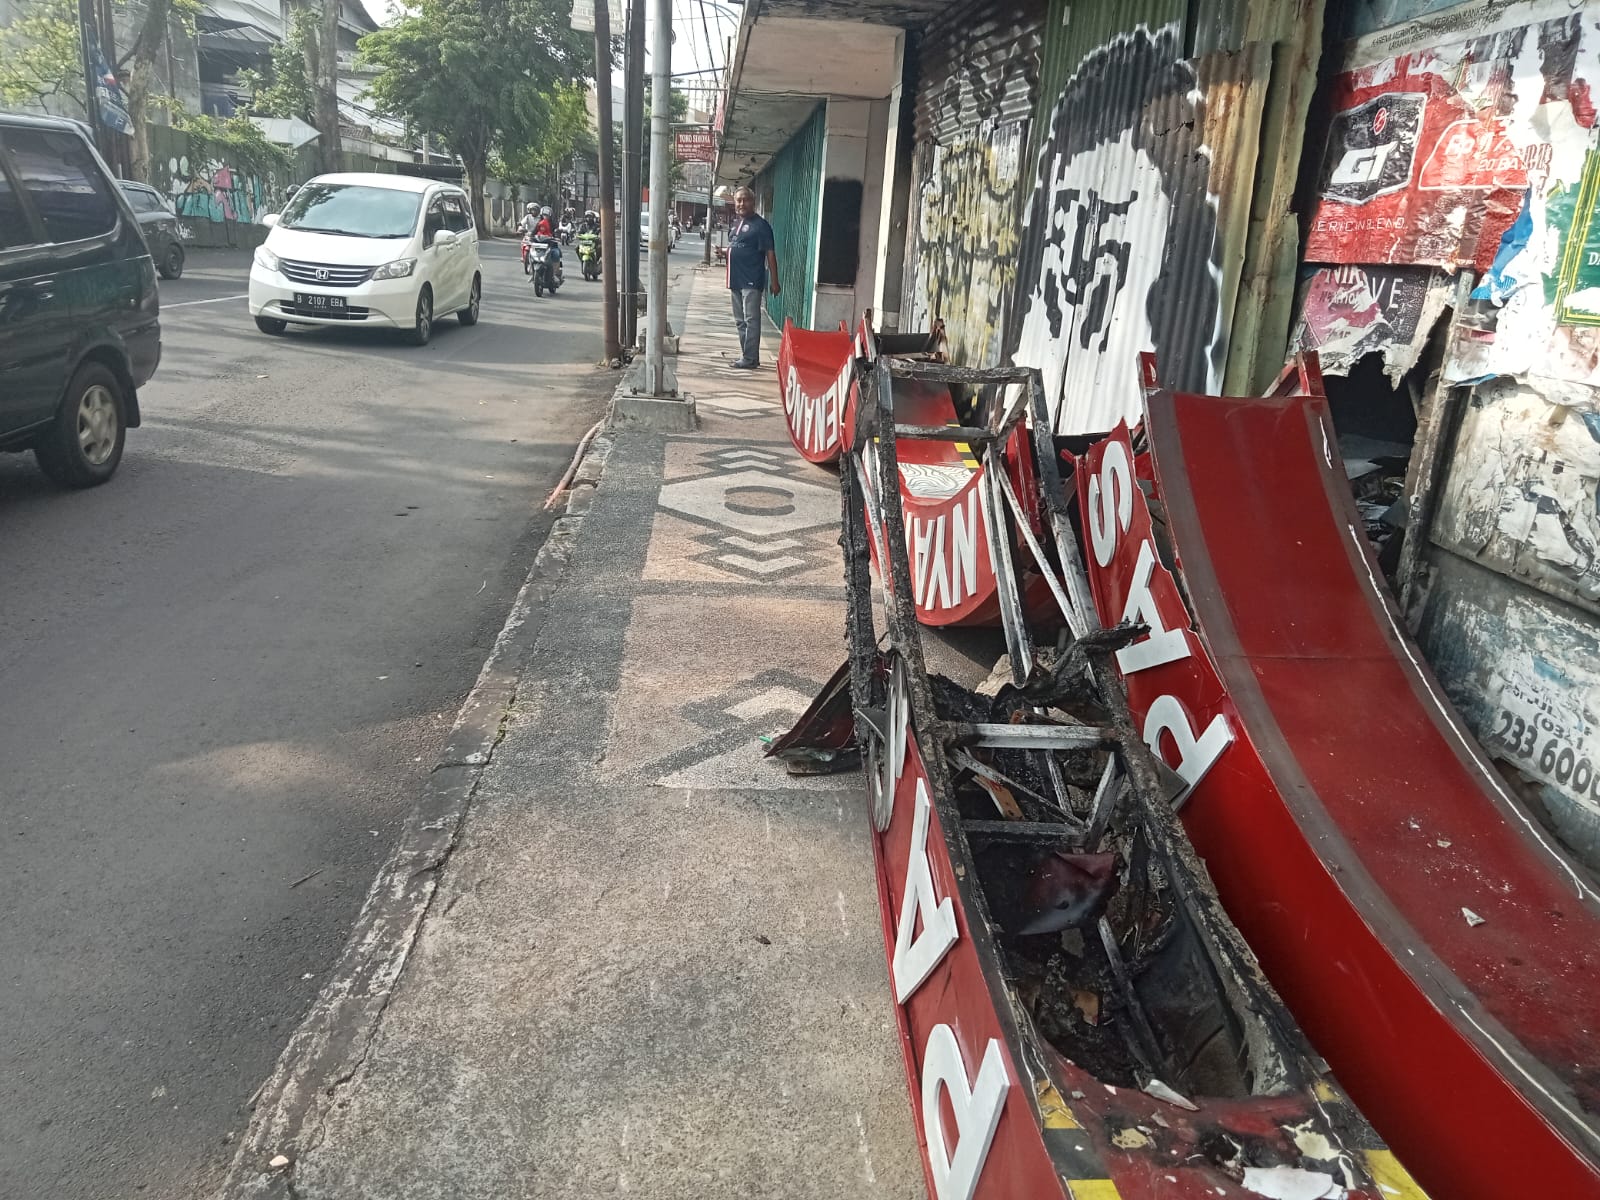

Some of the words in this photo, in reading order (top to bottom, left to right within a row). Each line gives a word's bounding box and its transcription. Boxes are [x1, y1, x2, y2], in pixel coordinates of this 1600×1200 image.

[679, 134, 692, 143] TOKO
[1498, 157, 1519, 170] BA
[297, 294, 302, 304] B
[308, 295, 326, 306] 2107
[330, 297, 344, 308] EBA
[1088, 440, 1235, 812] PAS
[1488, 710, 1538, 759] 233
